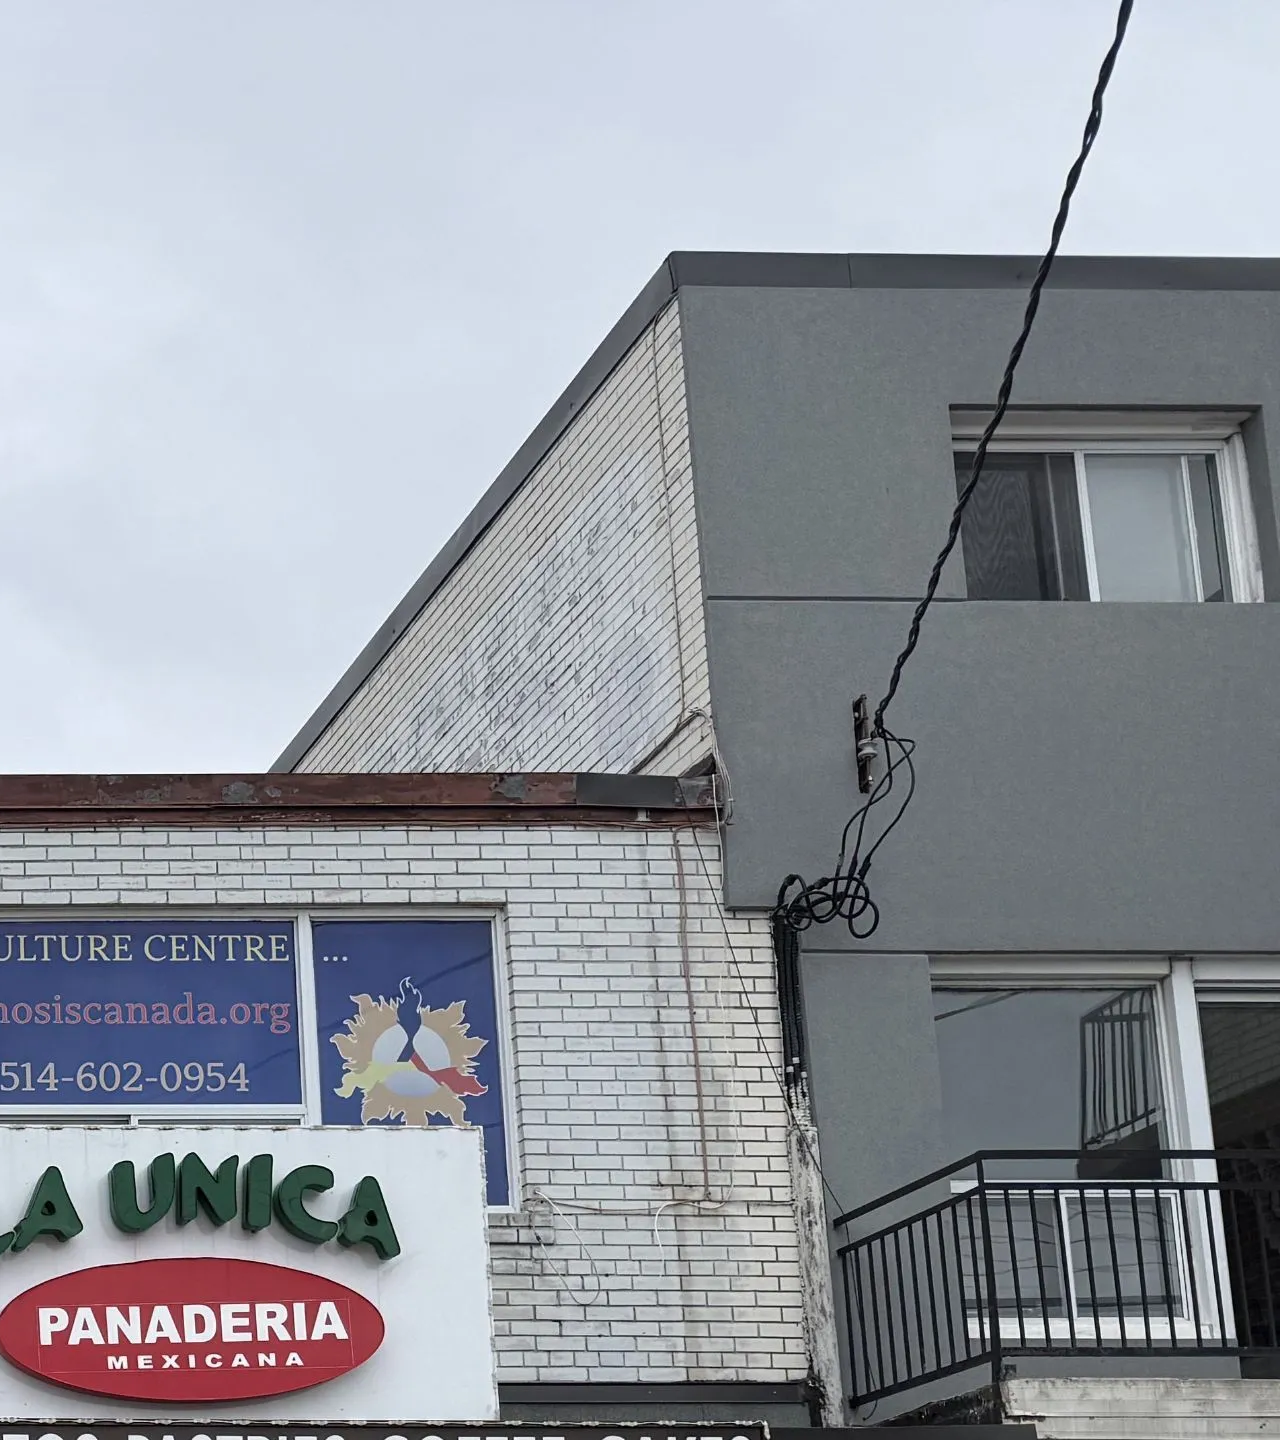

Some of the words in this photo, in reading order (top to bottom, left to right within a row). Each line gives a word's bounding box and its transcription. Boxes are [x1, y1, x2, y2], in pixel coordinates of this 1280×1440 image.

[143, 935, 290, 962] CENTRE
[0, 1061, 249, 1093] 514-602-0954
[108, 1152, 401, 1262] UNICA
[39, 1301, 348, 1346] PANADERIA
[107, 1352, 304, 1370] MEXICANA
